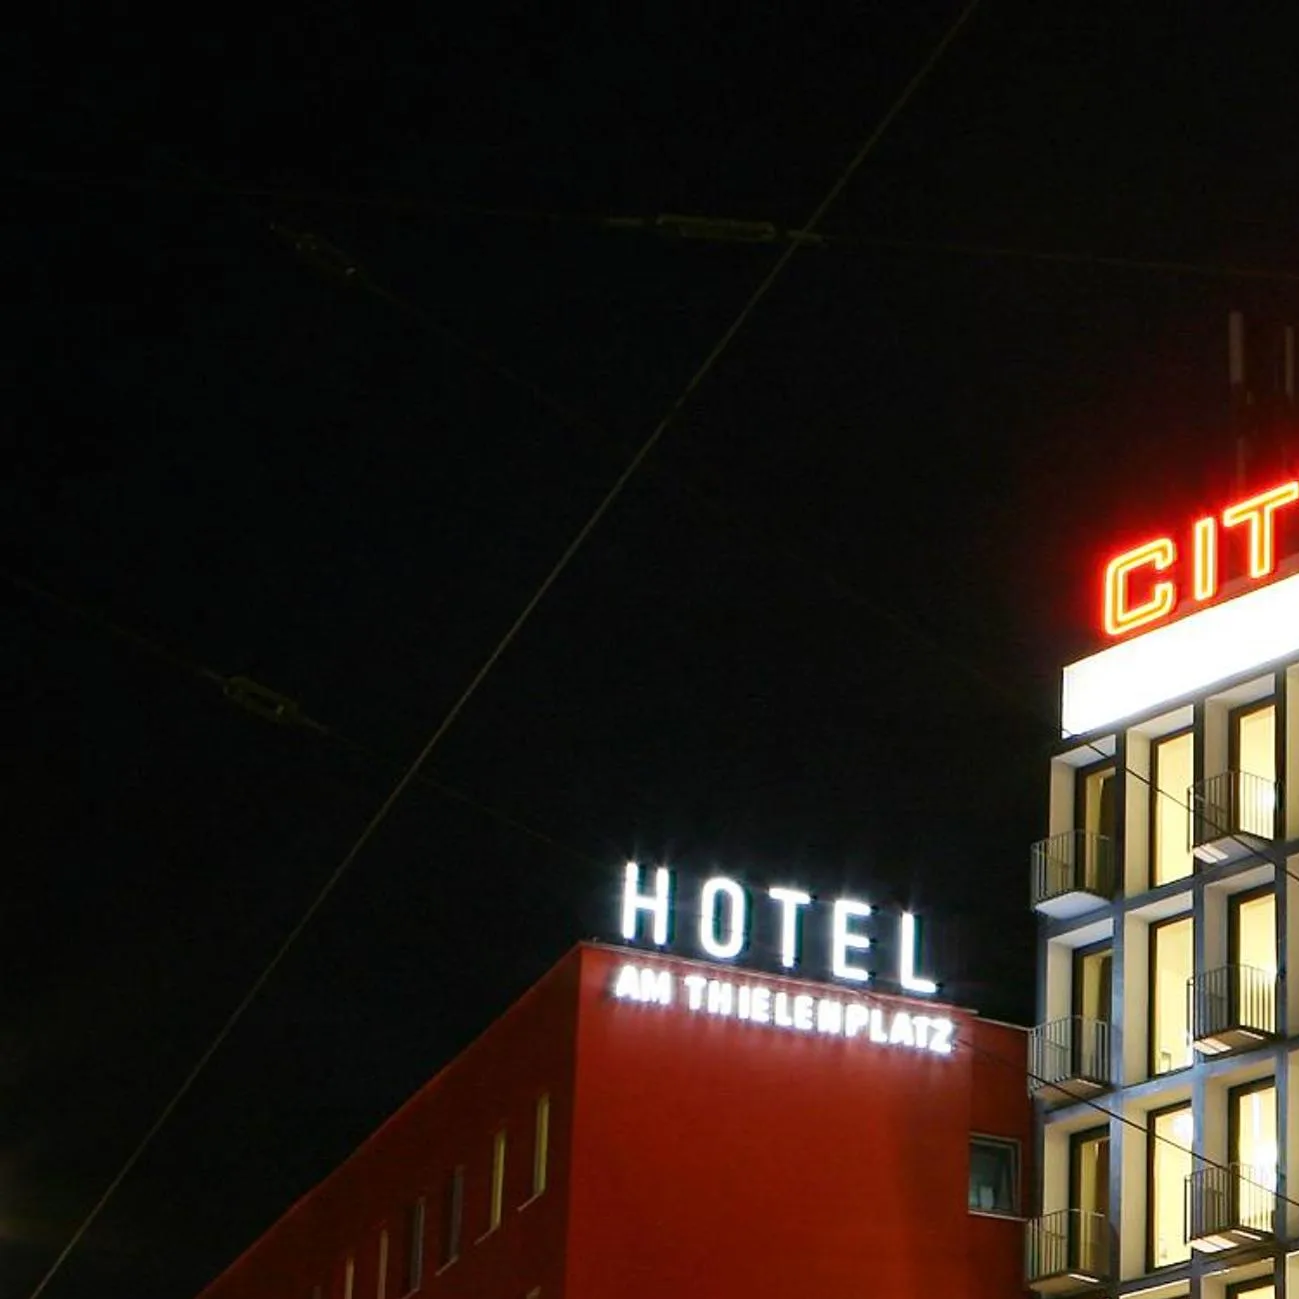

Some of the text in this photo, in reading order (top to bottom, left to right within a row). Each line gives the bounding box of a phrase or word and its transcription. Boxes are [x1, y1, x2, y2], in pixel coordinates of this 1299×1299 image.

[621, 860, 940, 995] HOTEL
[614, 964, 954, 1055] AM THIELENPLATZ
